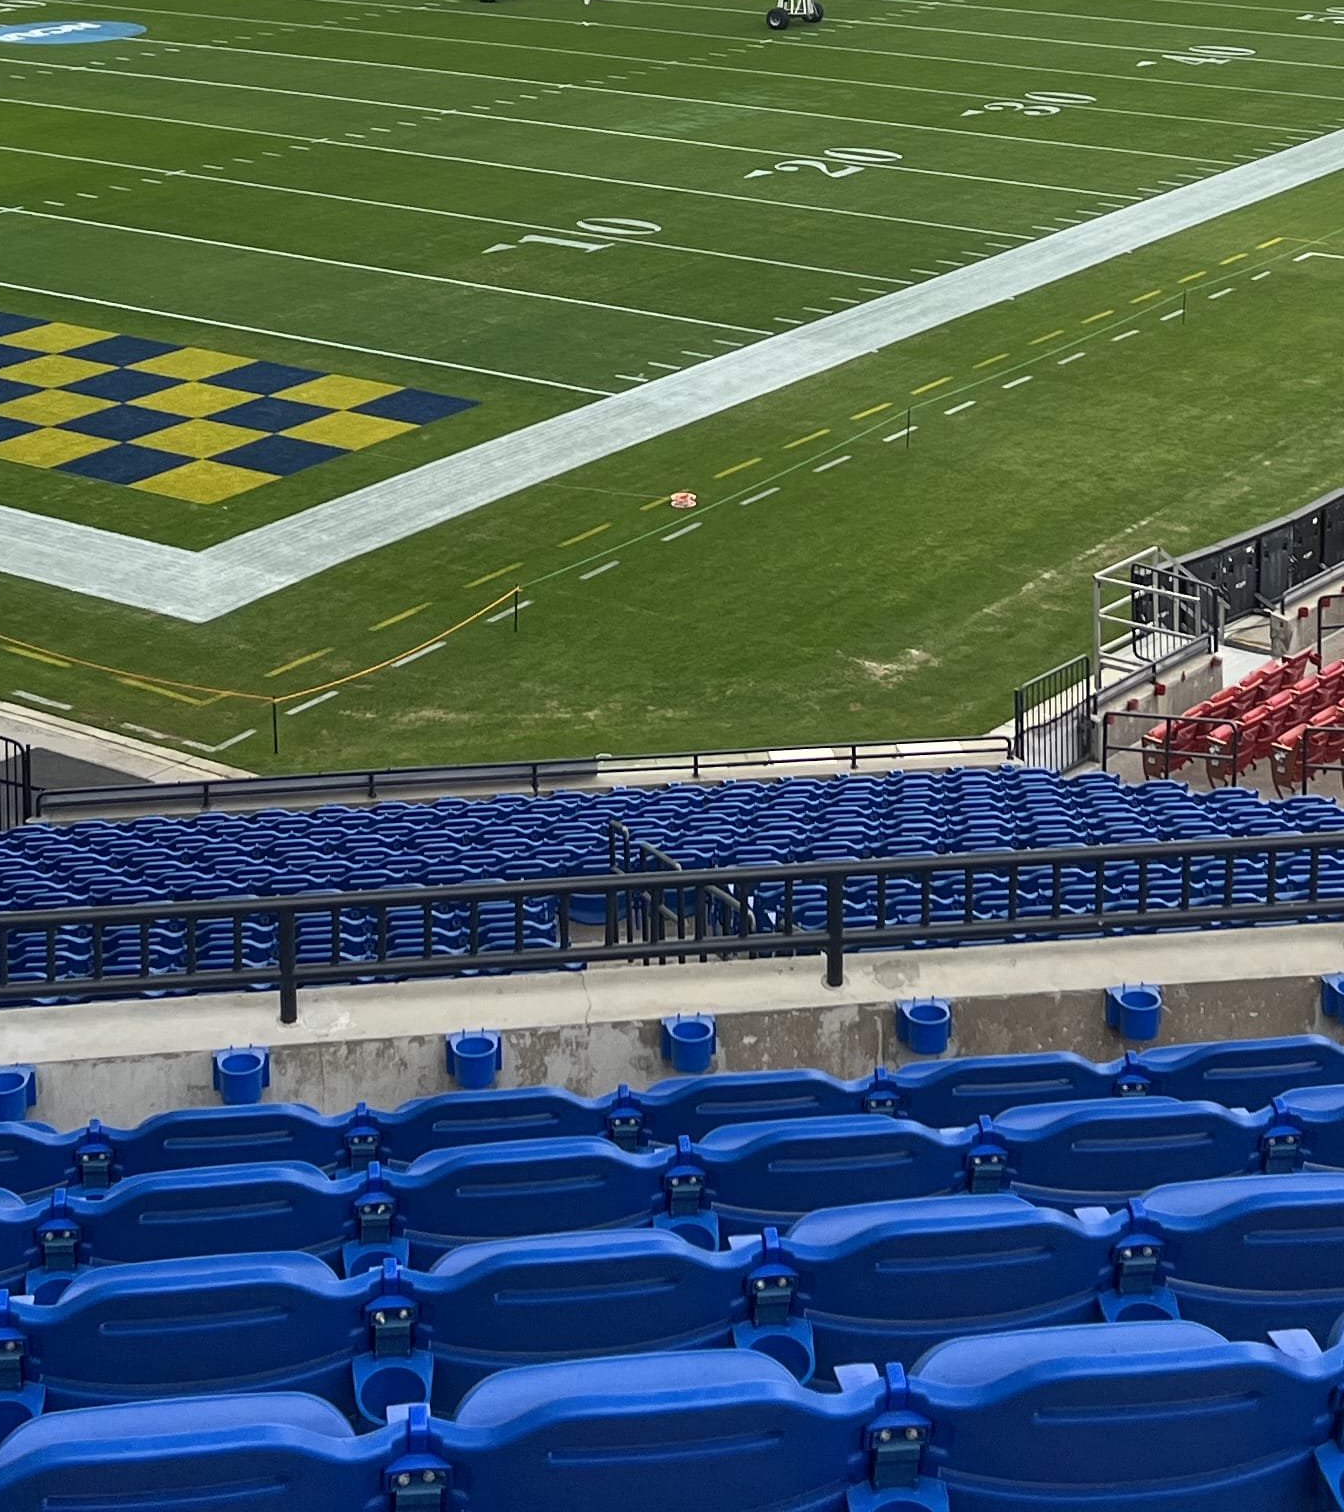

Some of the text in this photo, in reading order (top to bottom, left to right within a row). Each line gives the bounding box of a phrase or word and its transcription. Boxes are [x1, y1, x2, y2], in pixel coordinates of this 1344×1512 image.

[1161, 44, 1257, 65] 40
[983, 90, 1098, 117] 30
[774, 147, 903, 179] 20
[518, 217, 662, 253] 10
